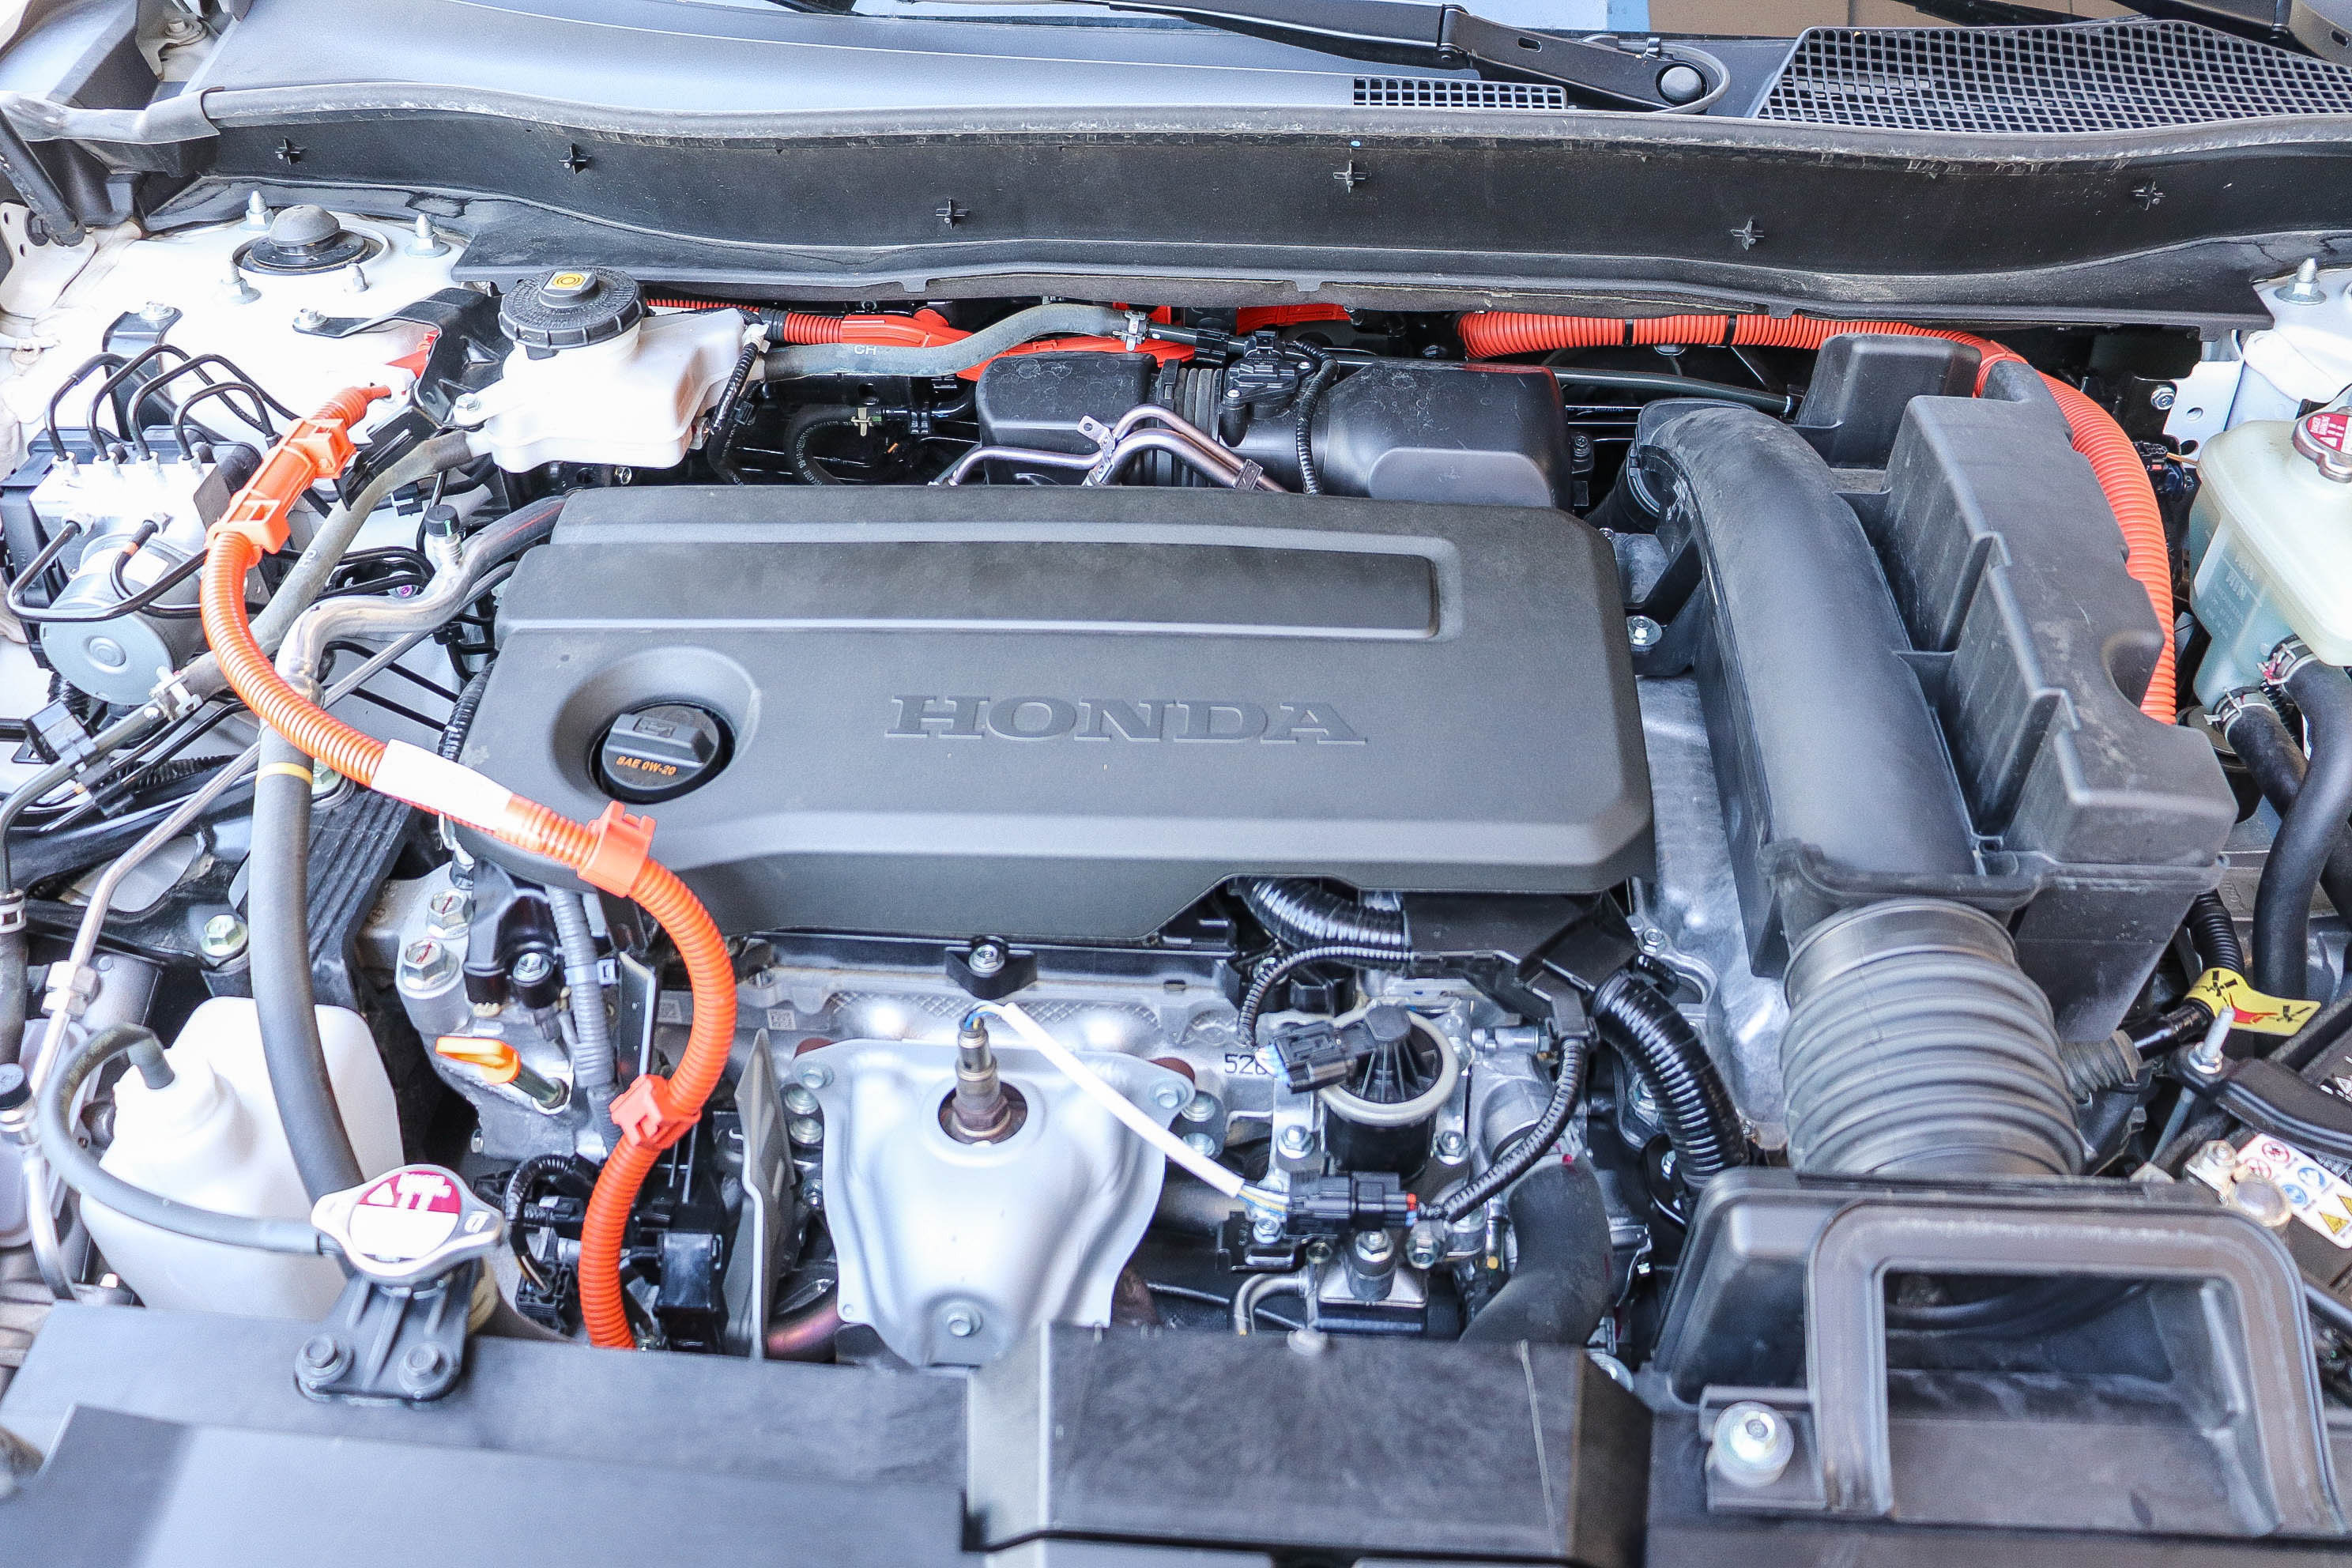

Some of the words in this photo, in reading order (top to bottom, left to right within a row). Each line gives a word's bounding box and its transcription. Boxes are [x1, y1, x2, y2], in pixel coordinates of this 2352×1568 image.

[854, 345, 876, 356] CH
[884, 695, 1368, 745] HONDA
[616, 756, 642, 769] SAE
[641, 760, 677, 776] 0W-20
